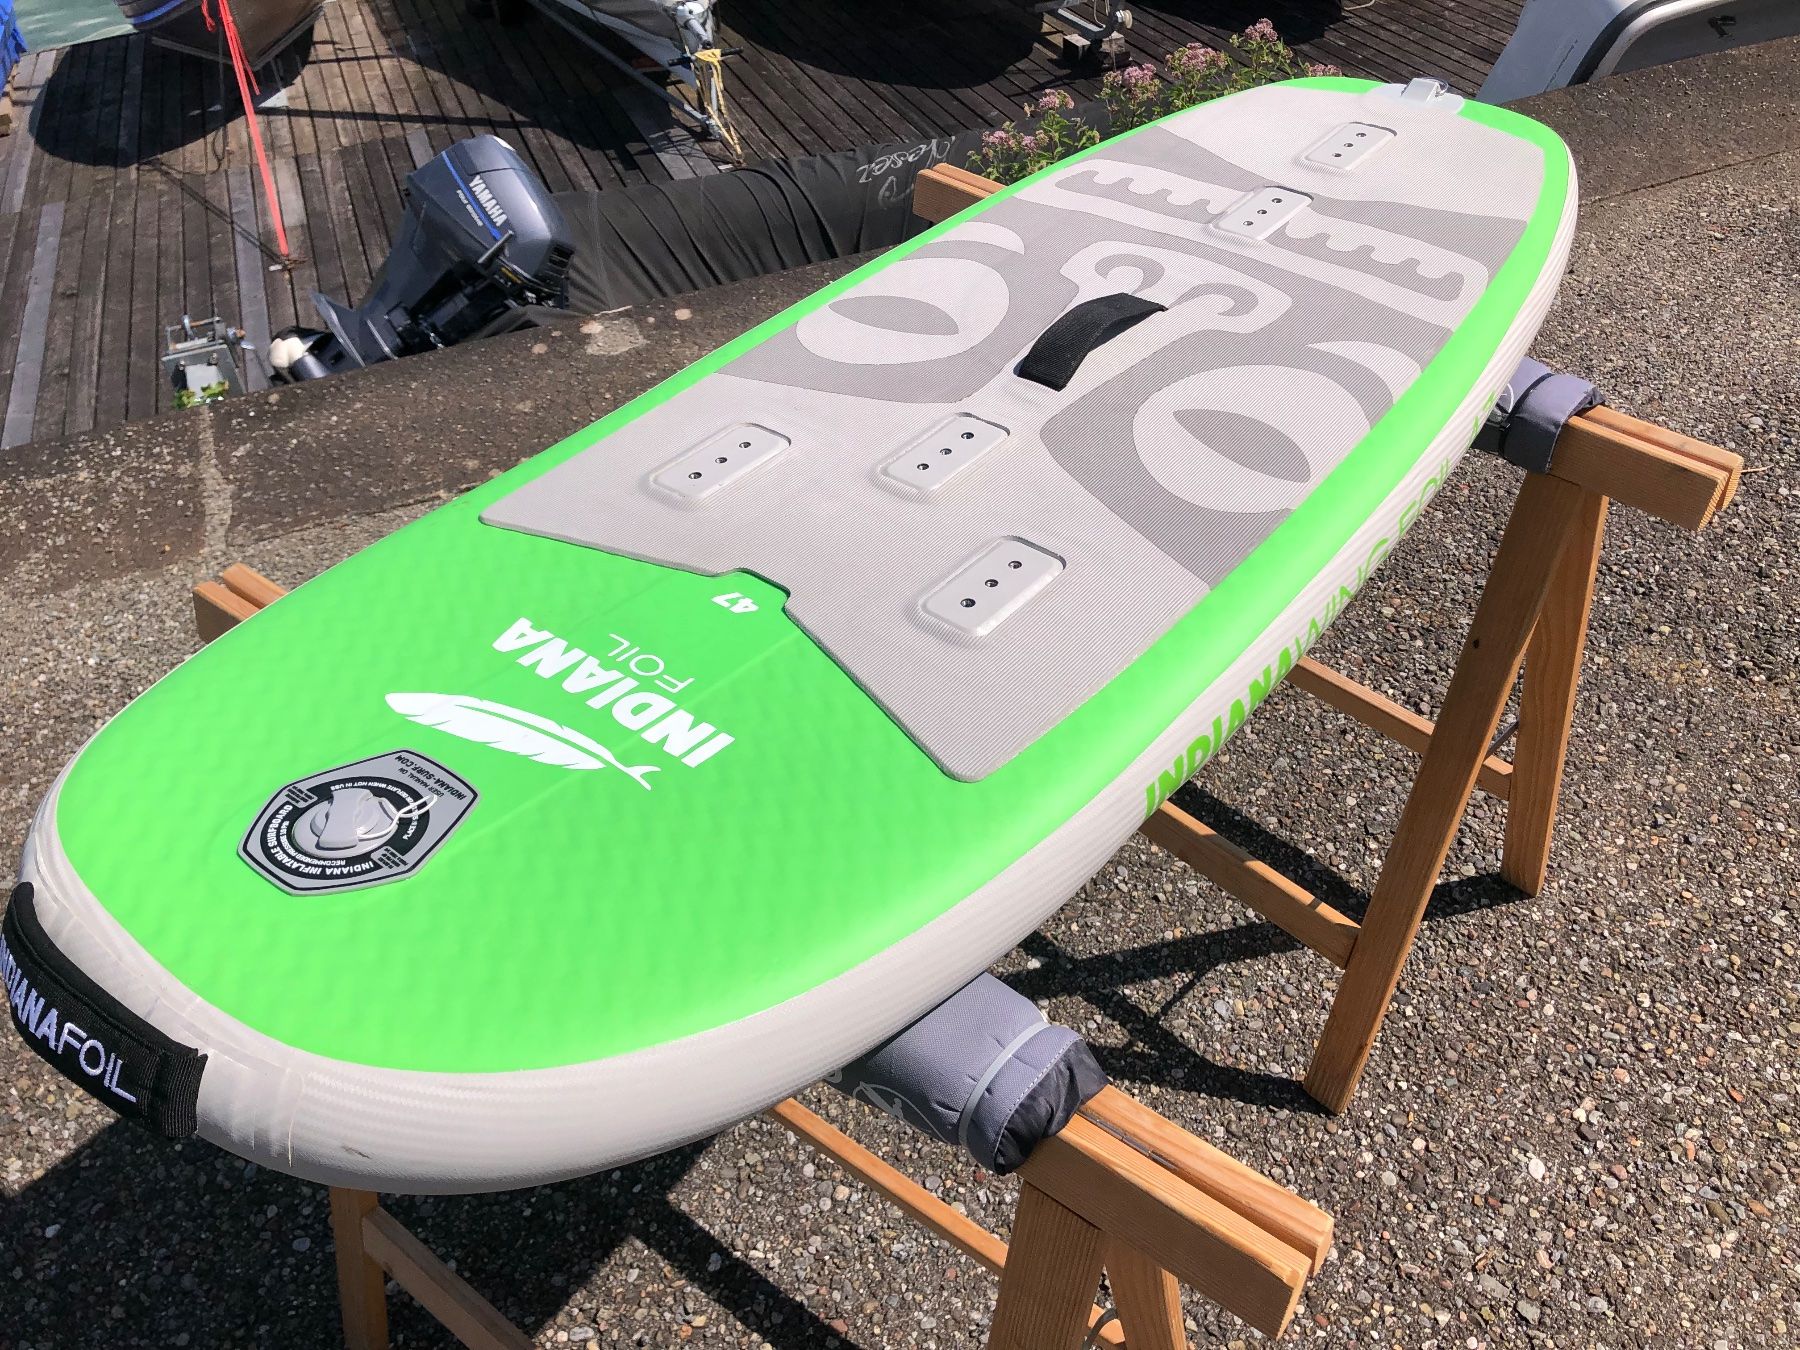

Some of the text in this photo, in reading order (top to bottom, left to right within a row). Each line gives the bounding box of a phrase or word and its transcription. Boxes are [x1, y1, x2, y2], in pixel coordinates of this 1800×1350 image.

[468, 175, 508, 227] YAMAHA
[710, 591, 760, 614] 47
[607, 633, 695, 694] FOIL
[491, 617, 736, 768] INDIANA
[1145, 646, 1292, 817] INDIANA
[394, 754, 468, 801] INDIANA-SURF.COM
[266, 804, 374, 875] INDIANA INFLATABLE SURFBOARD
[280, 835, 298, 856] PRESSURE
[296, 853, 346, 866] RECOMMENDED
